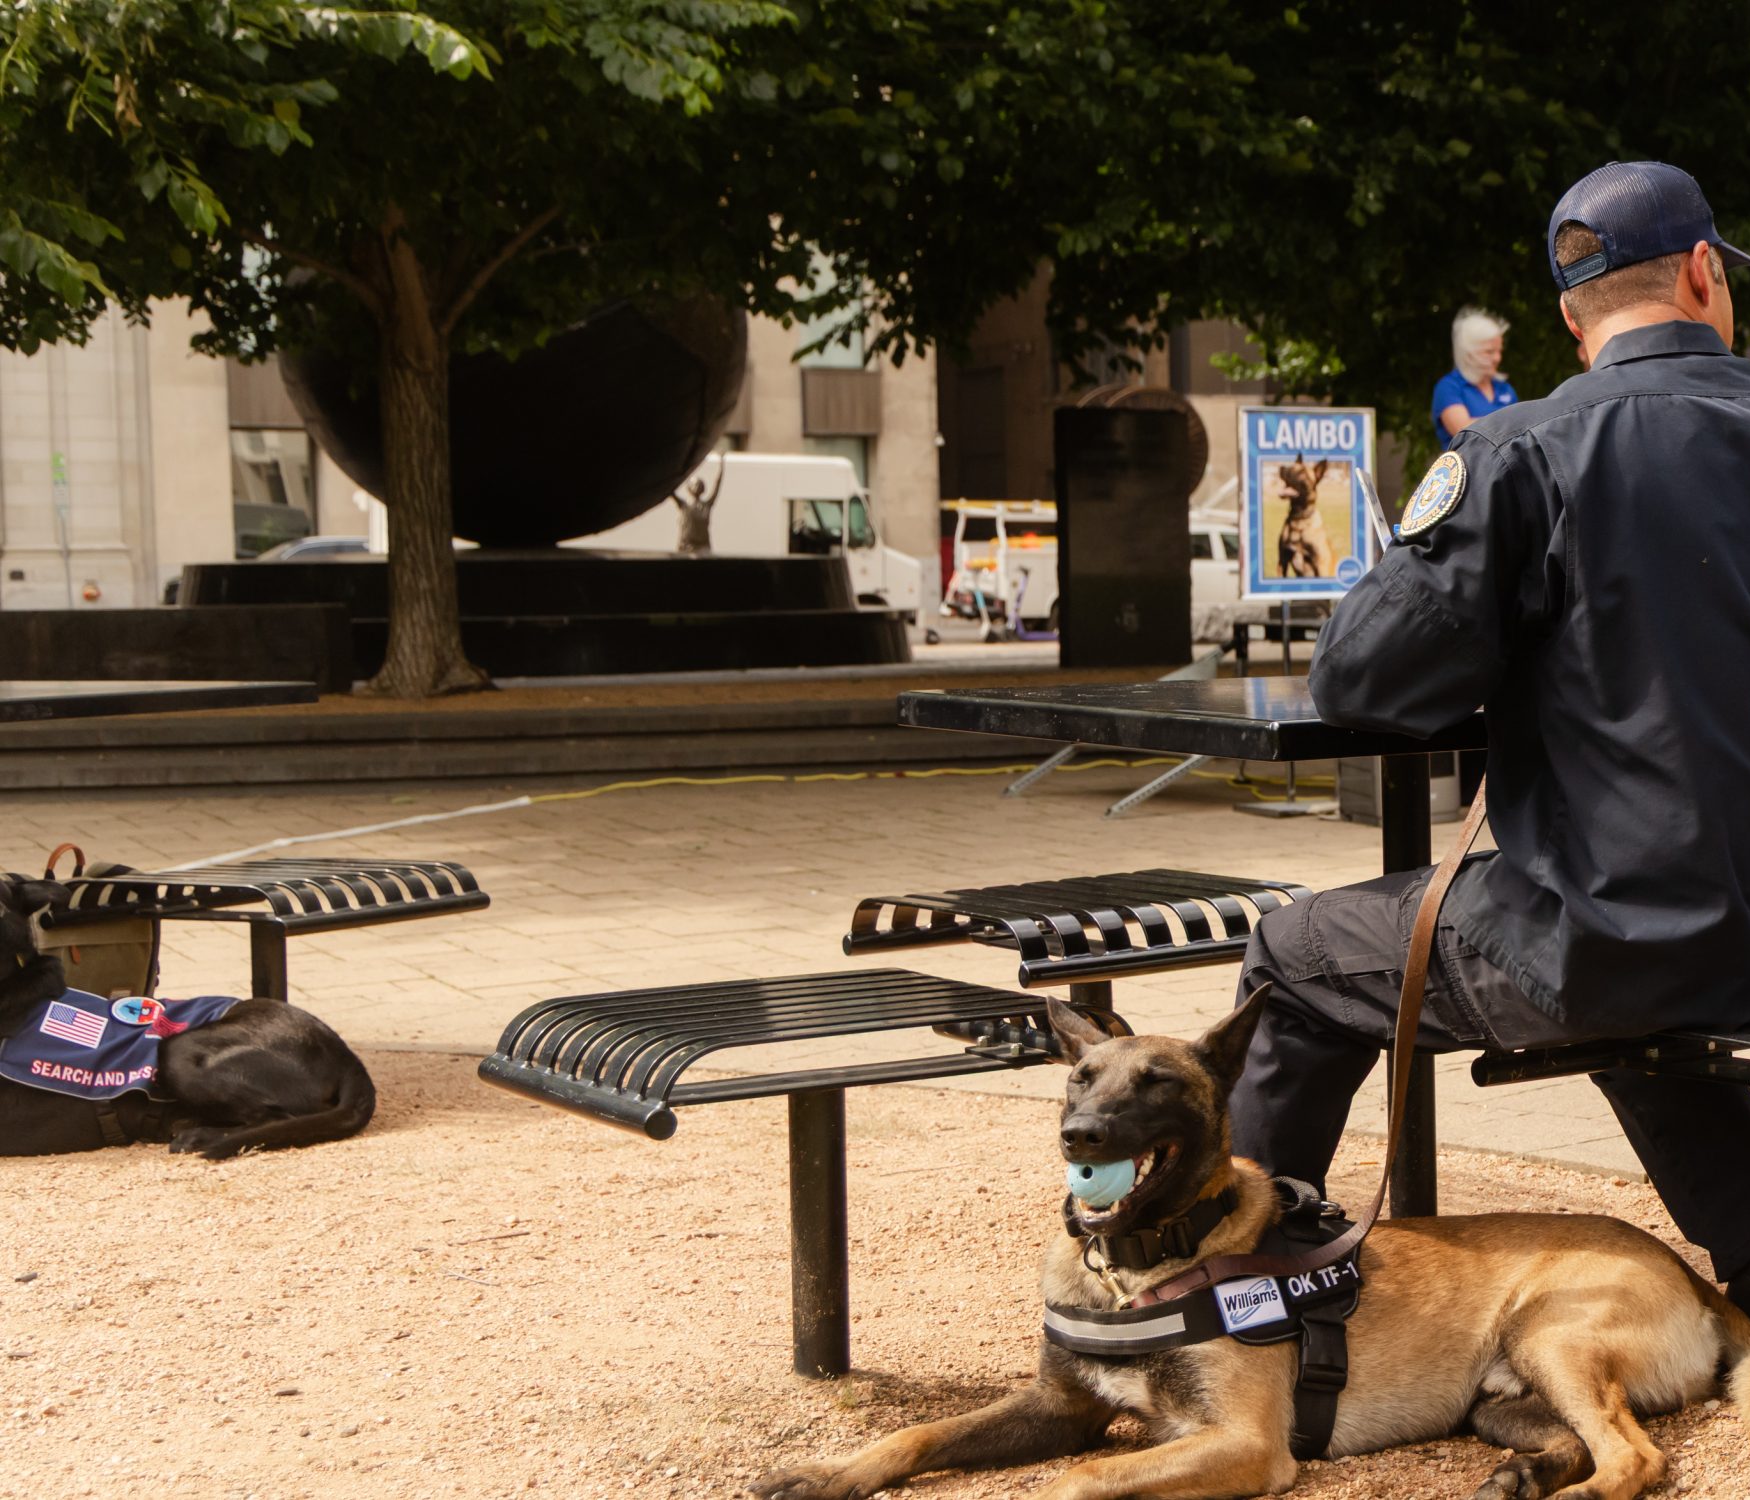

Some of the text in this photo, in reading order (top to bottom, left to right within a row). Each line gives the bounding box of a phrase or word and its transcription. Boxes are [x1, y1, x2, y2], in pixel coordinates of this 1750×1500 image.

[1258, 419, 1356, 450] LAMBO
[31, 1059, 93, 1086] SEARCH
[94, 1072, 125, 1086] AND
[1287, 1261, 1359, 1297] OK TF-1
[1224, 1288, 1278, 1311] Williams
